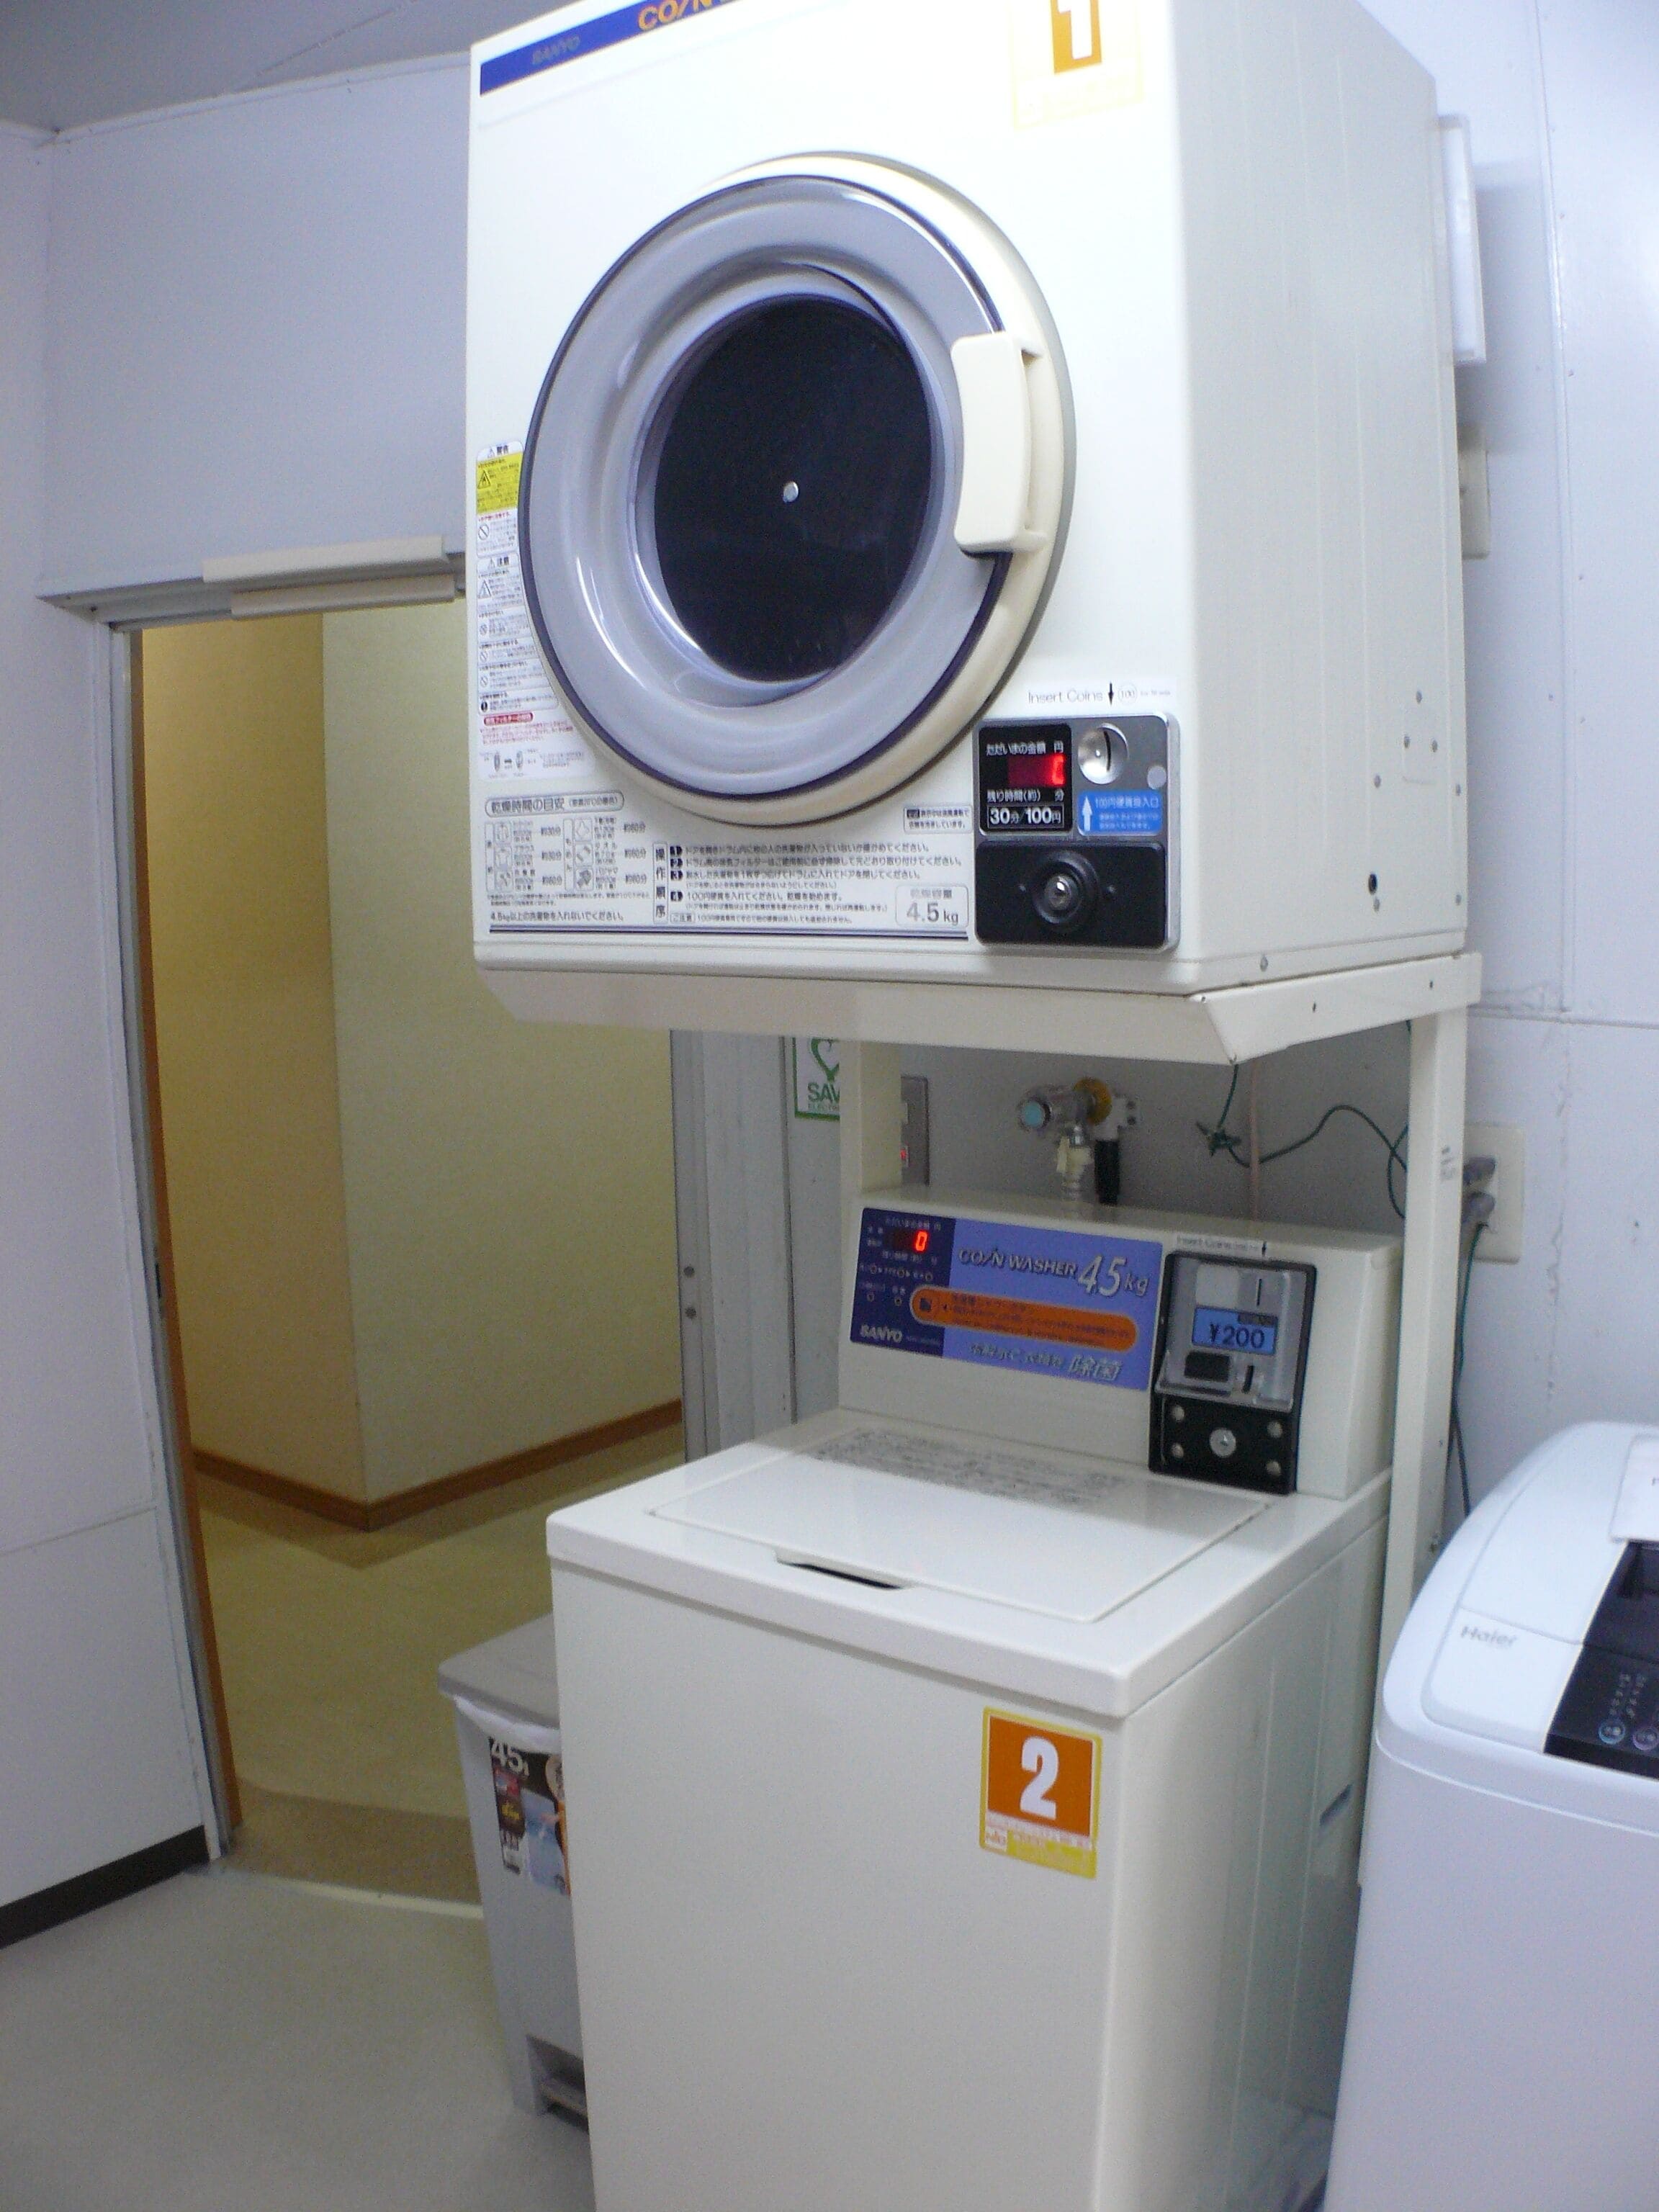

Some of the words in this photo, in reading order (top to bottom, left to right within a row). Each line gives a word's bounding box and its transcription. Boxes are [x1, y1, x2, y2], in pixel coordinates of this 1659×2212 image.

[1058, 0, 1093, 60] 1
[1028, 691, 1063, 703] Insert
[1067, 687, 1103, 703] Coins
[915, 1231, 928, 1251] 0
[1009, 1254, 1079, 1280] WASHER
[860, 1324, 902, 1343] SANYO
[1460, 1625, 1518, 1647] Haier
[1020, 1735, 1059, 1820] 2
